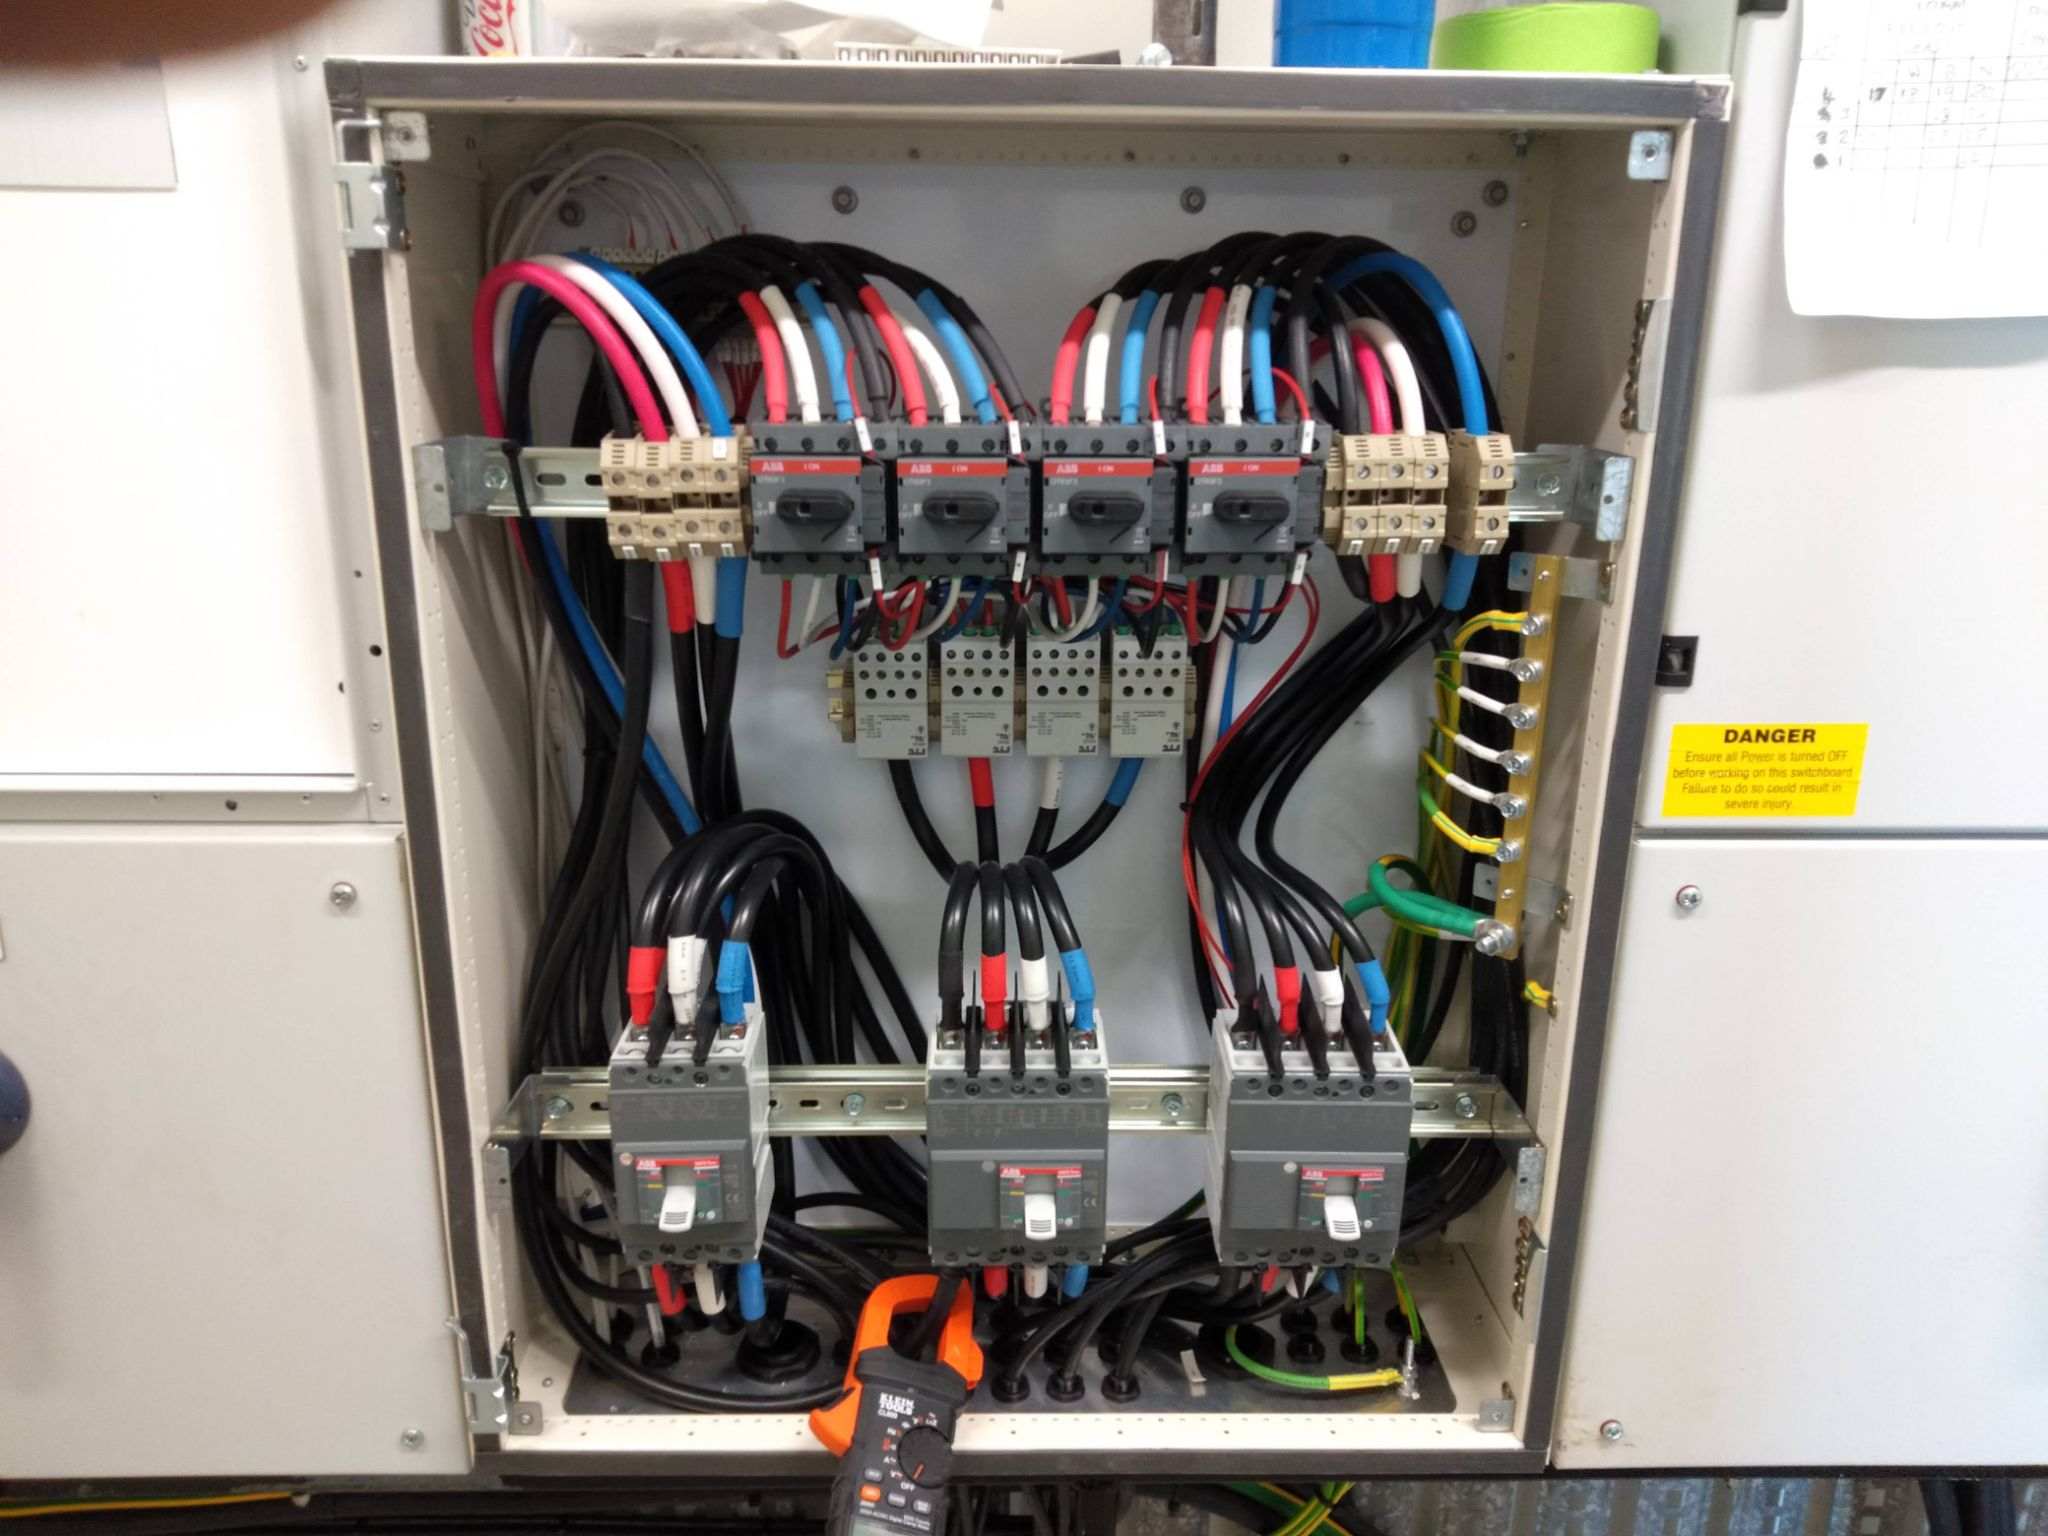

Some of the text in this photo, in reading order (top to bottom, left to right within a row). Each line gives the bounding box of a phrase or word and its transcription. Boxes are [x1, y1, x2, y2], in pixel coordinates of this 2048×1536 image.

[762, 462, 784, 472] ABB
[910, 463, 932, 474] ABB
[1056, 464, 1078, 474] ABB
[1202, 464, 1224, 473] ABB
[1724, 729, 1816, 744] DANGER
[1685, 750, 1848, 762] Ensure all Power is turned OFF
[1673, 766, 1852, 780] before working on this switchboard
[1682, 782, 1842, 794] Failure to do so could result in
[1725, 800, 1759, 809] severe
[880, 1392, 914, 1407] KLEIN
[879, 1402, 914, 1416] TOOLS
[901, 1482, 916, 1491] OFF
